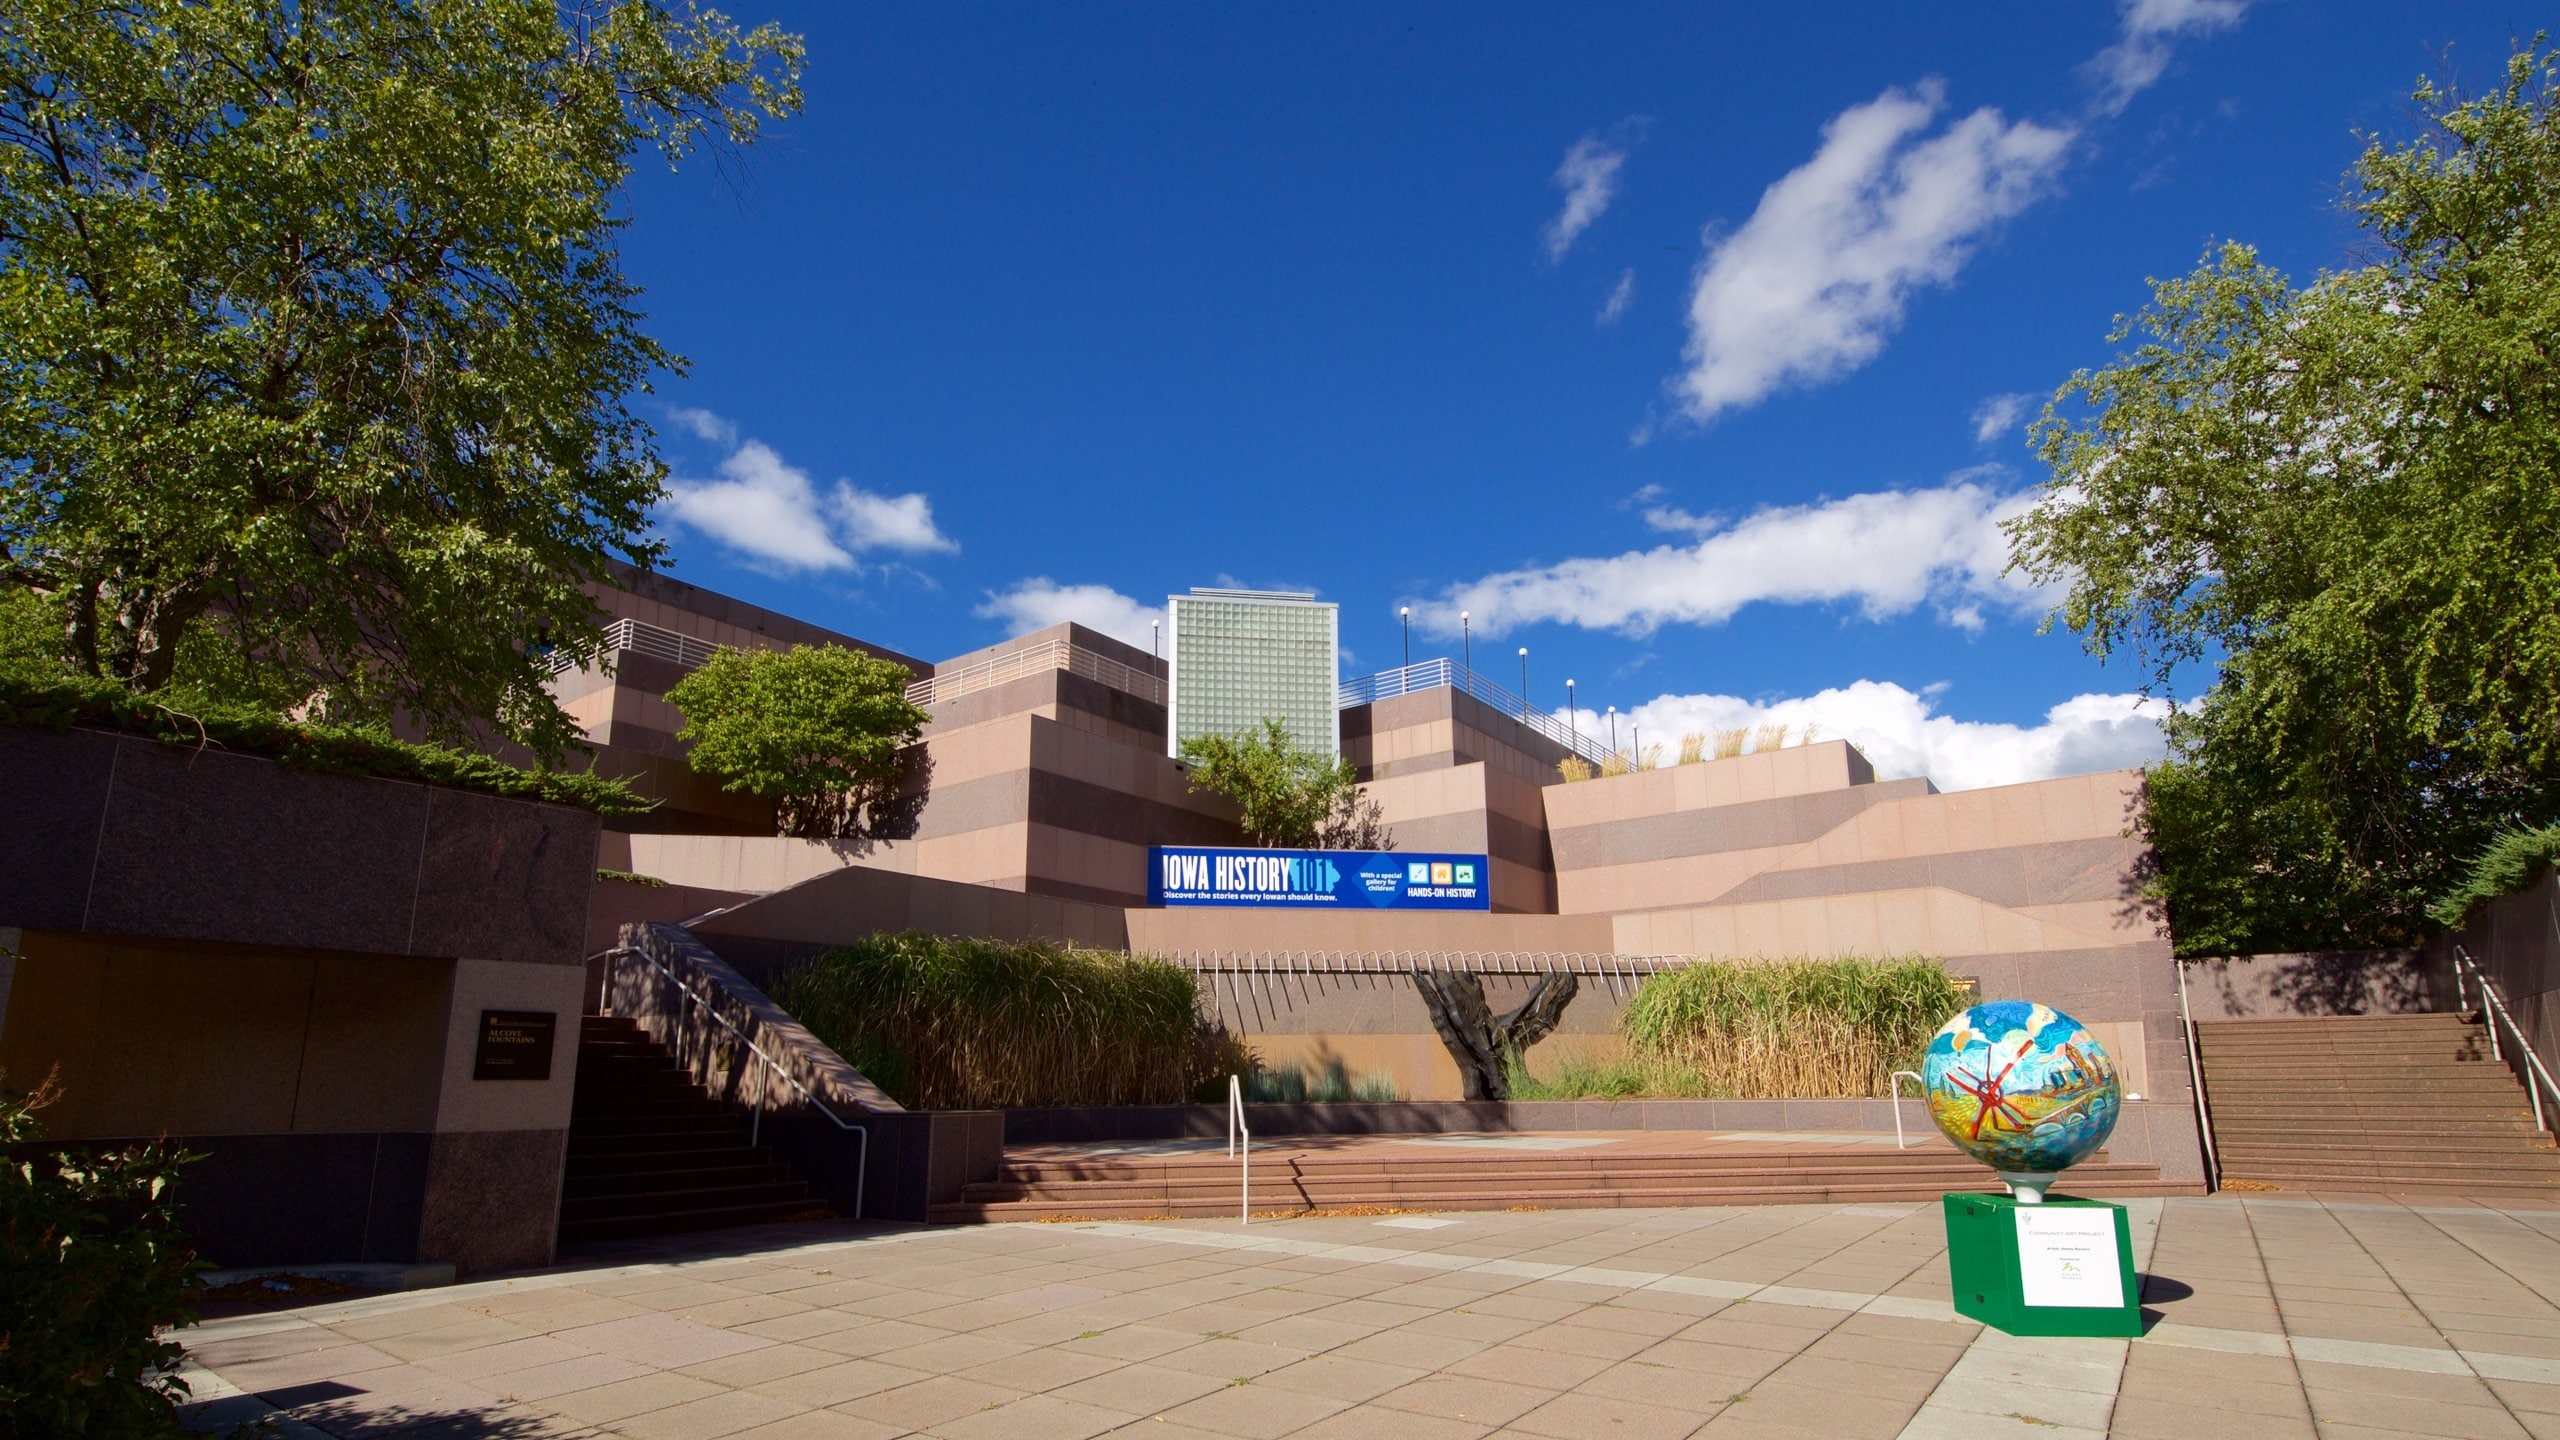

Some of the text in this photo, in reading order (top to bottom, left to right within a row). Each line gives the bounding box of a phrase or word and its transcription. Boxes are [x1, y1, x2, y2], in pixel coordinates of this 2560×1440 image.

[1163, 855, 1327, 892] IOWA HISTORY 101
[1212, 892, 1239, 900] stories
[1240, 893, 1261, 901] every
[1287, 893, 1313, 901] should
[1315, 893, 1338, 901] know.
[1408, 888, 1476, 898] HANDS-ON HISTORY
